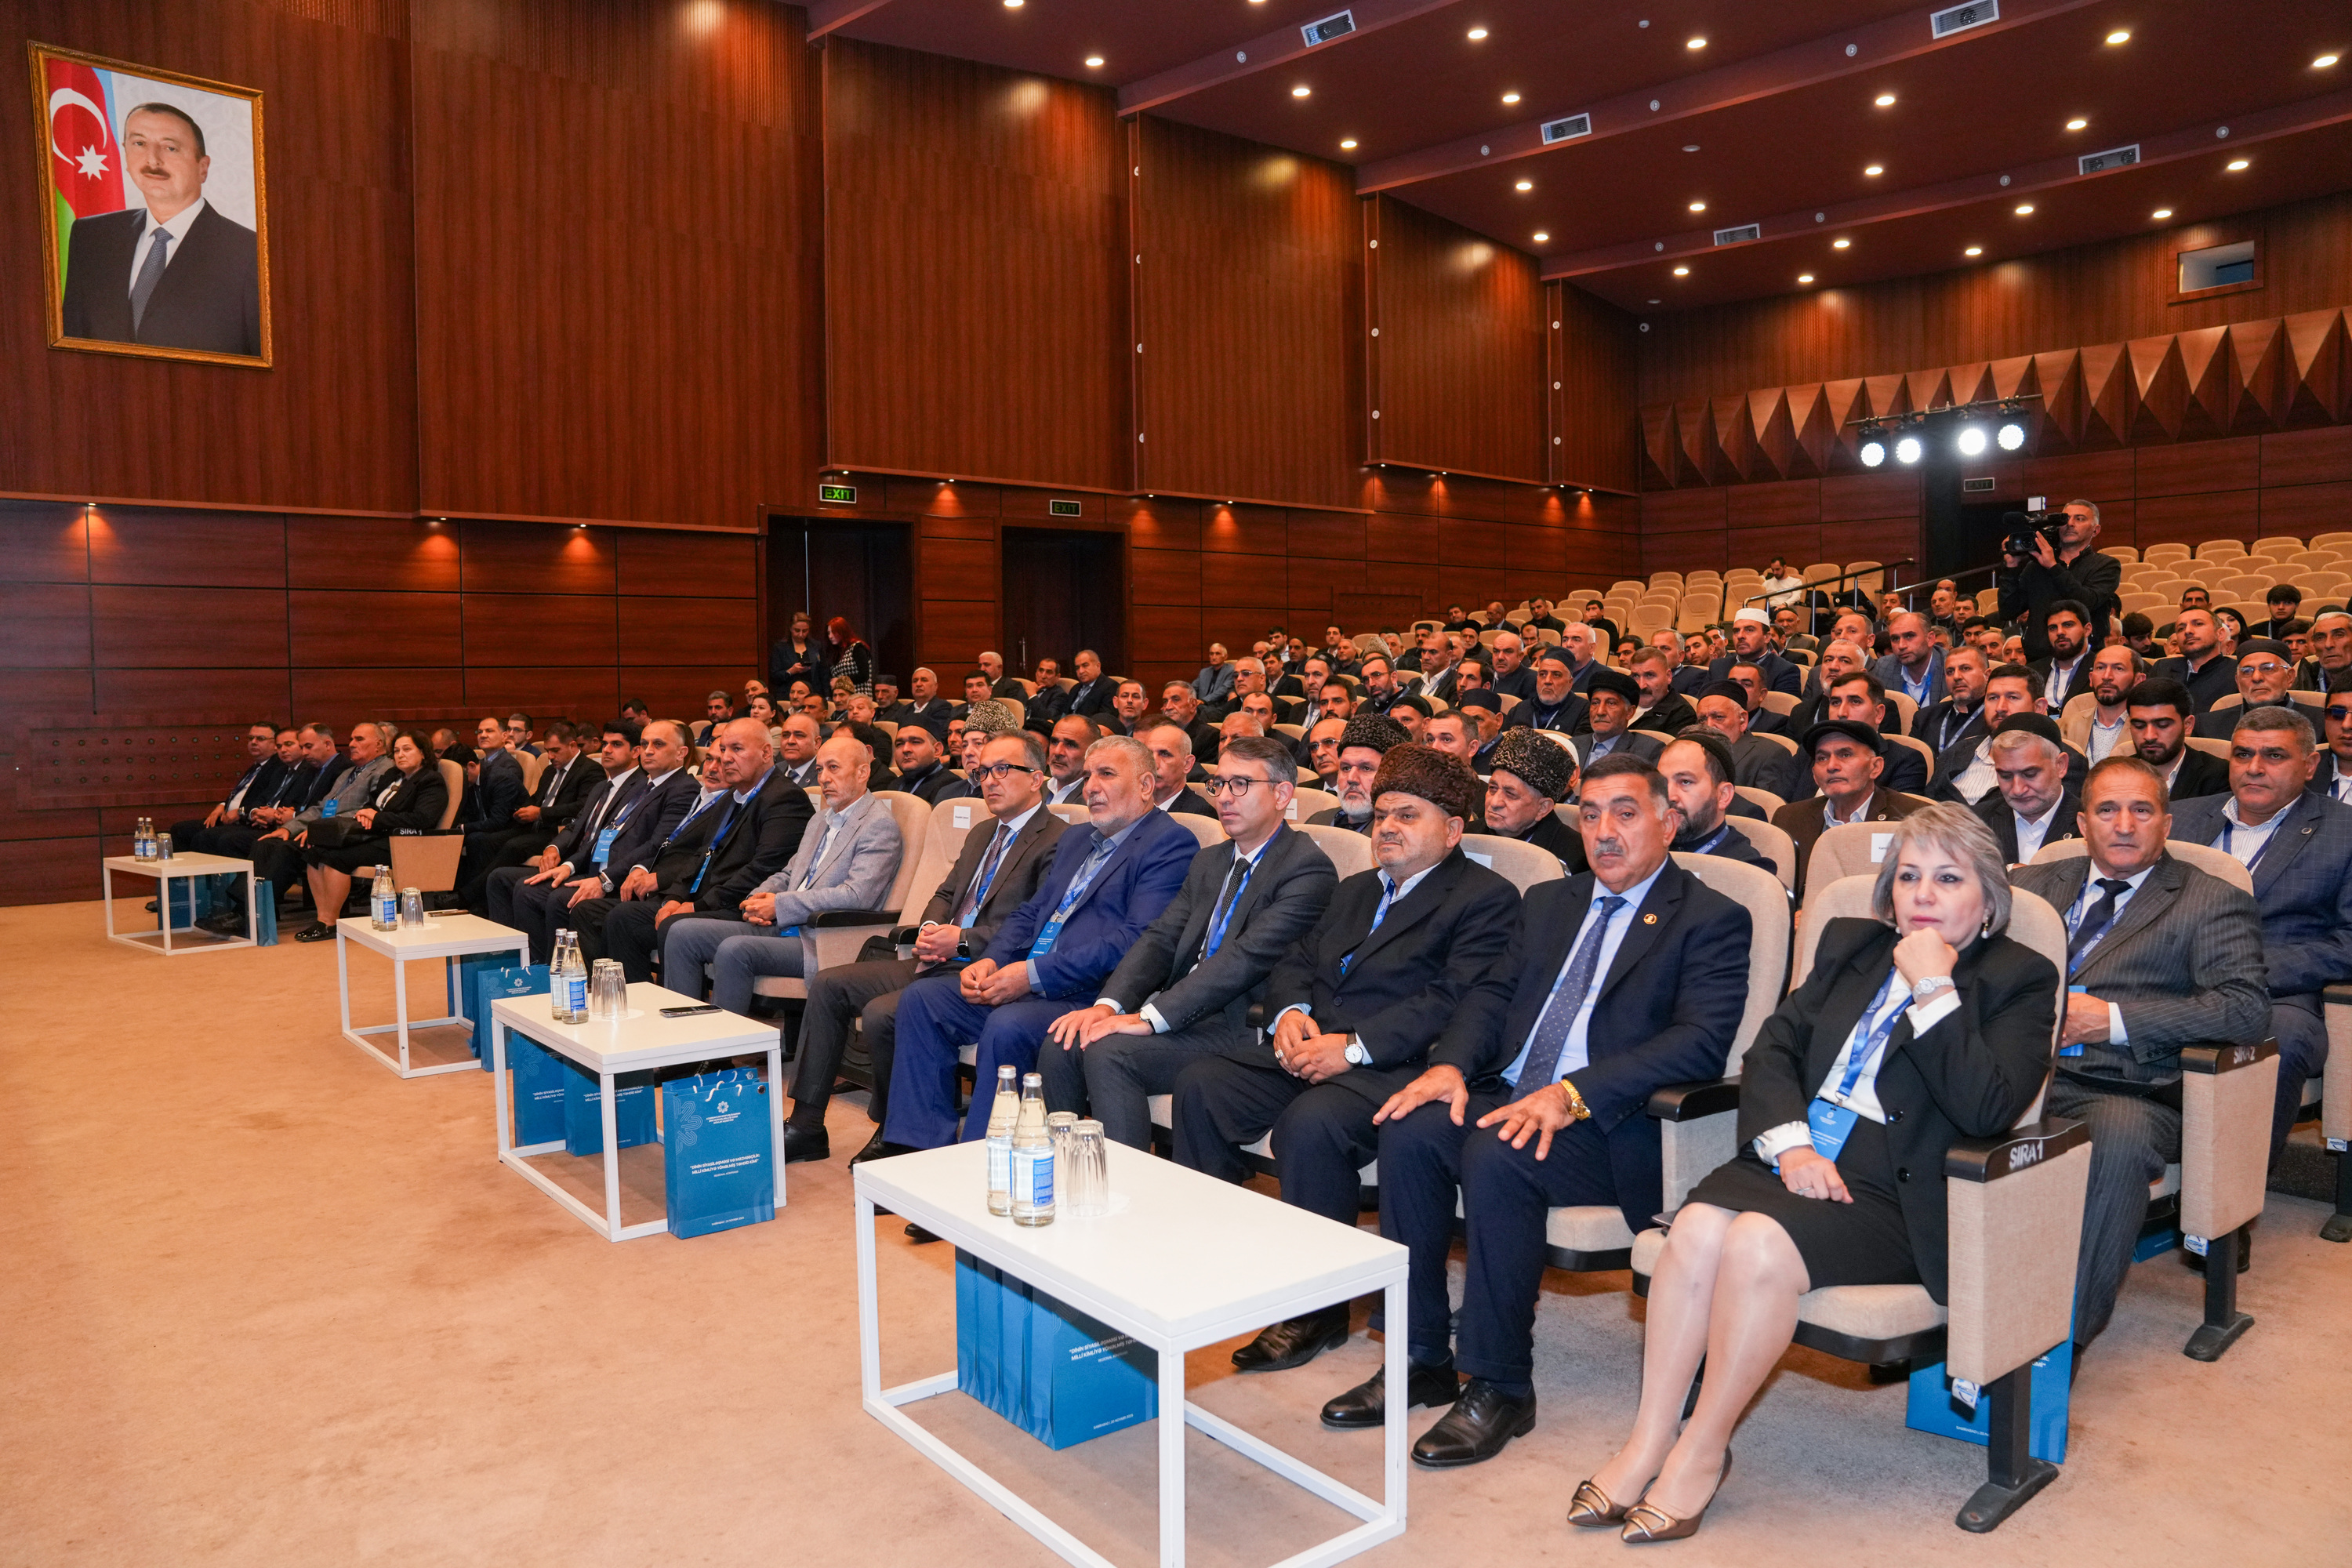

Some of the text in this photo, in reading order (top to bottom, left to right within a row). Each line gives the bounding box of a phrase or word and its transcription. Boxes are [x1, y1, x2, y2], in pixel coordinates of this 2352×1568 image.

[825, 488, 851, 499] EXIT
[1054, 503, 1076, 514] EXIT
[2009, 1139, 2043, 1170] SIRA 1
[1071, 1352, 1083, 1361] MİLLİ
[1083, 1348, 1102, 1357] KİMLİYƏ
